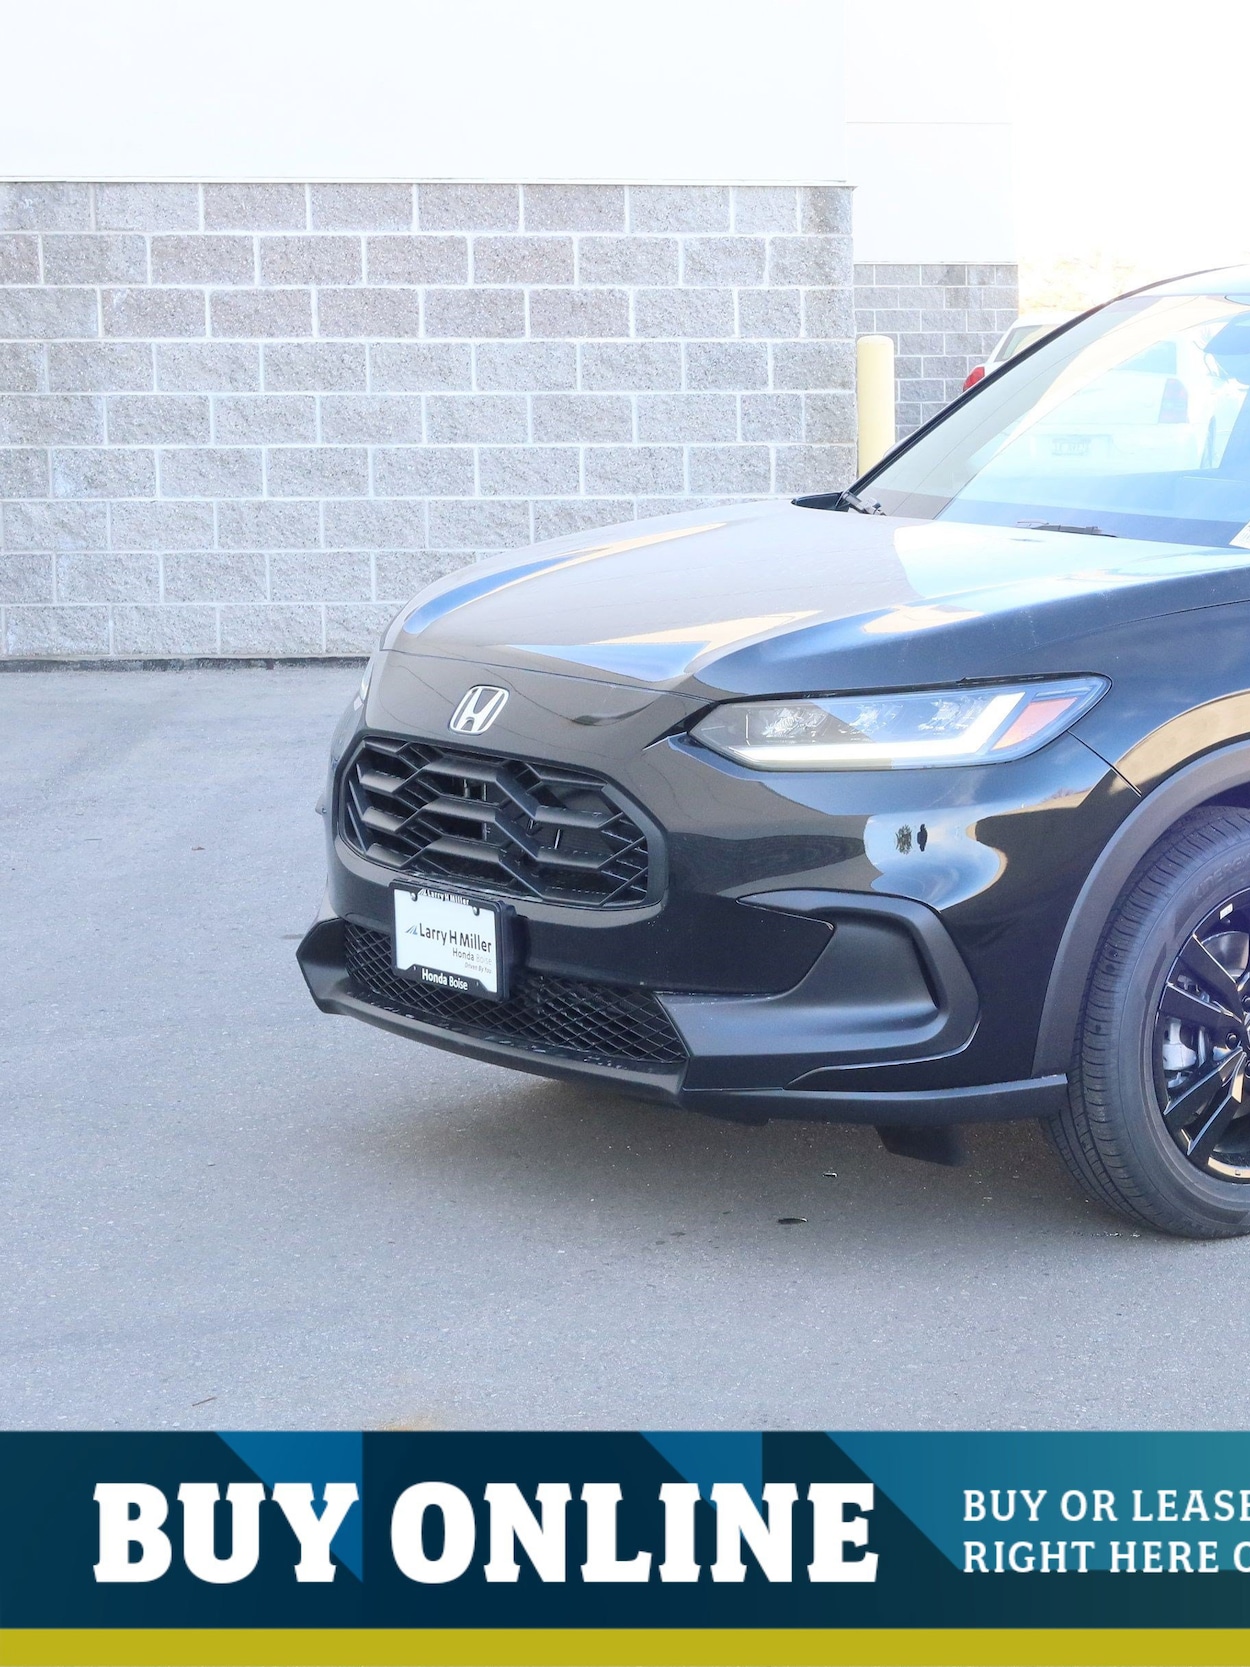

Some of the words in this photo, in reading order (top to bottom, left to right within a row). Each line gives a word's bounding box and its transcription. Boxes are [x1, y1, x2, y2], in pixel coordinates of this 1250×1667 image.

[419, 923, 447, 946] Larry
[449, 930, 457, 945] H
[459, 932, 492, 953] Miller
[452, 947, 475, 962] Honda
[422, 968, 448, 986] Honda
[449, 976, 468, 991] Boise
